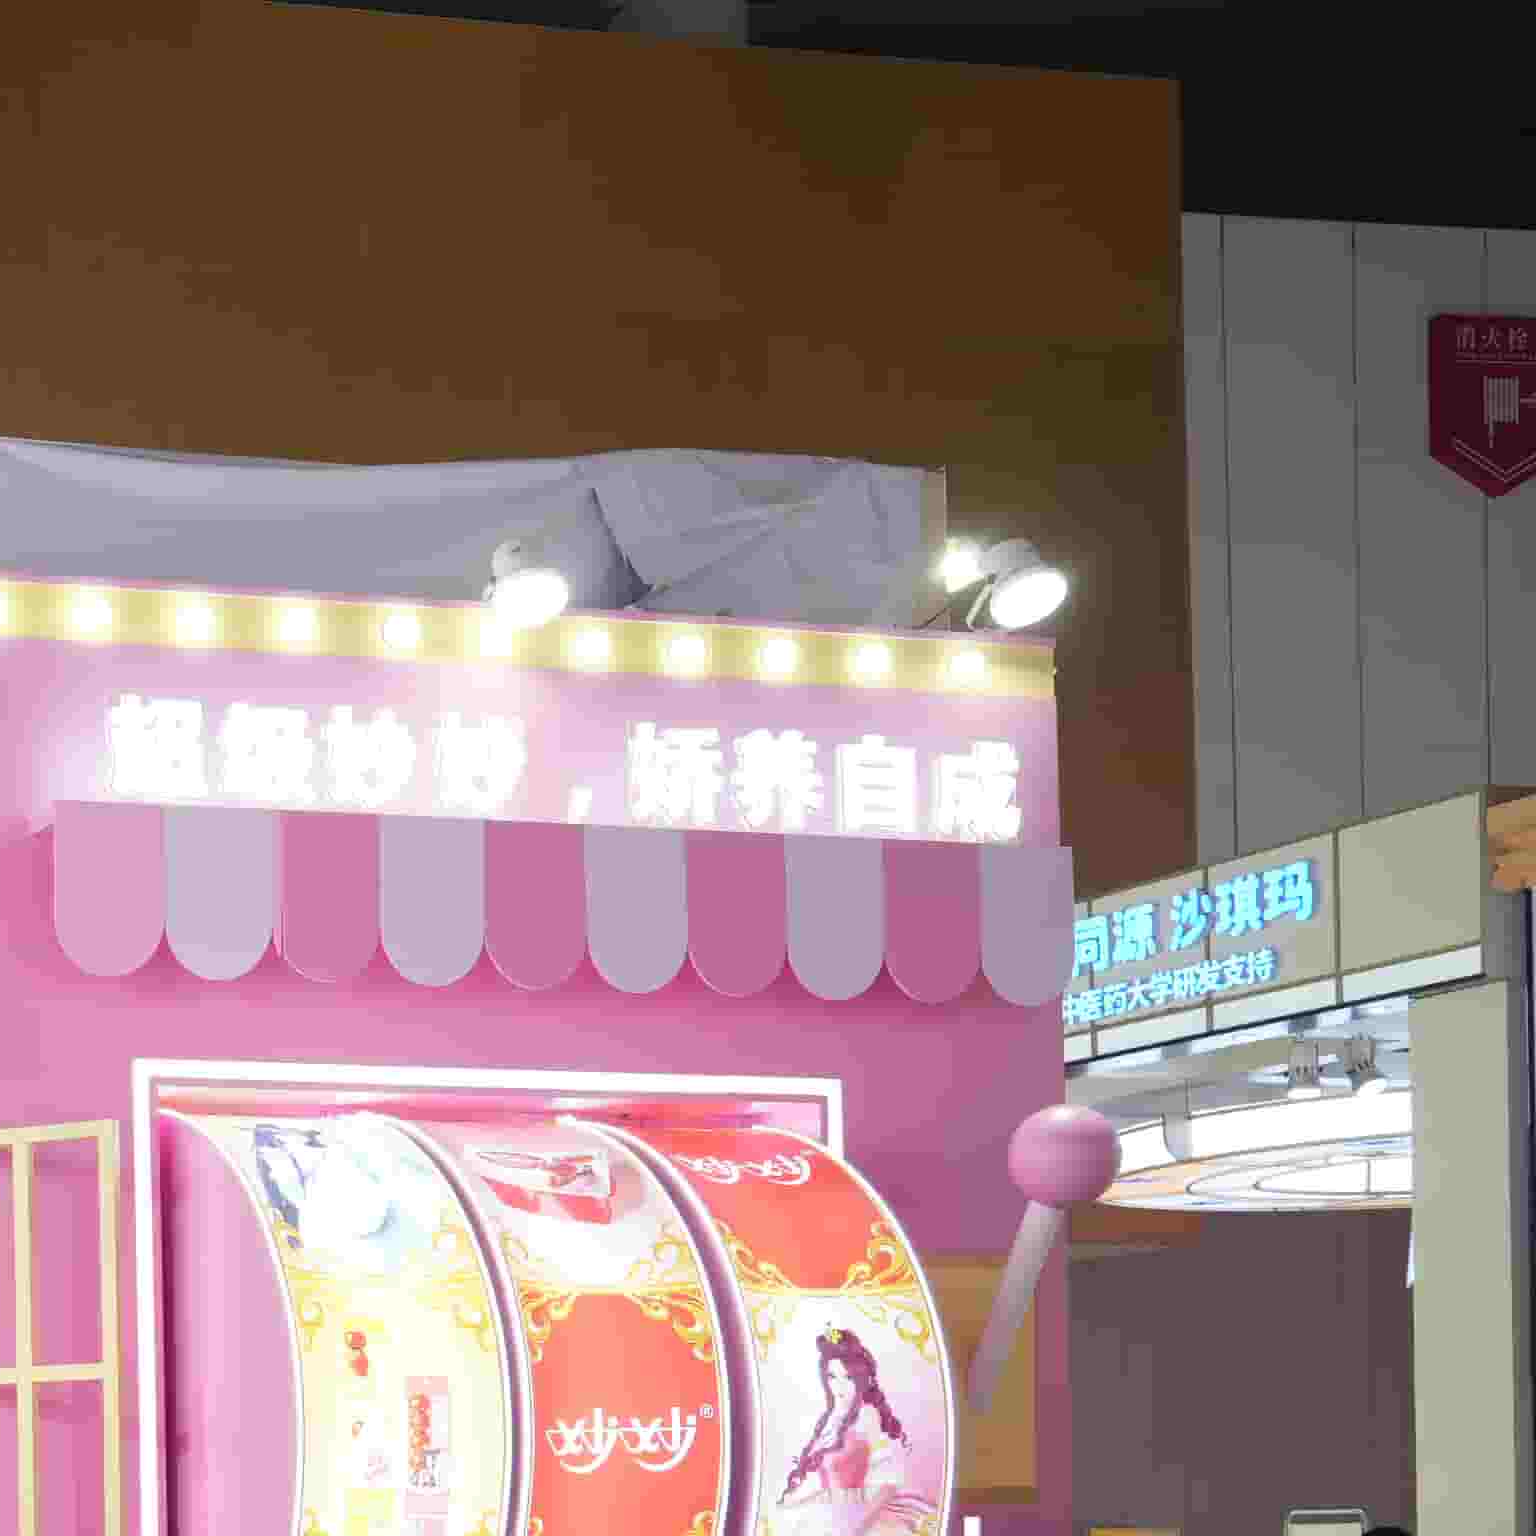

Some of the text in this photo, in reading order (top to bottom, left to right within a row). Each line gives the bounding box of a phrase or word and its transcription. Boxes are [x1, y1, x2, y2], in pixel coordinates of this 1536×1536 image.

[1072, 858, 1315, 979] 同源 沙琪玛
[1063, 946, 1276, 1026] 中医药大学研发支持
